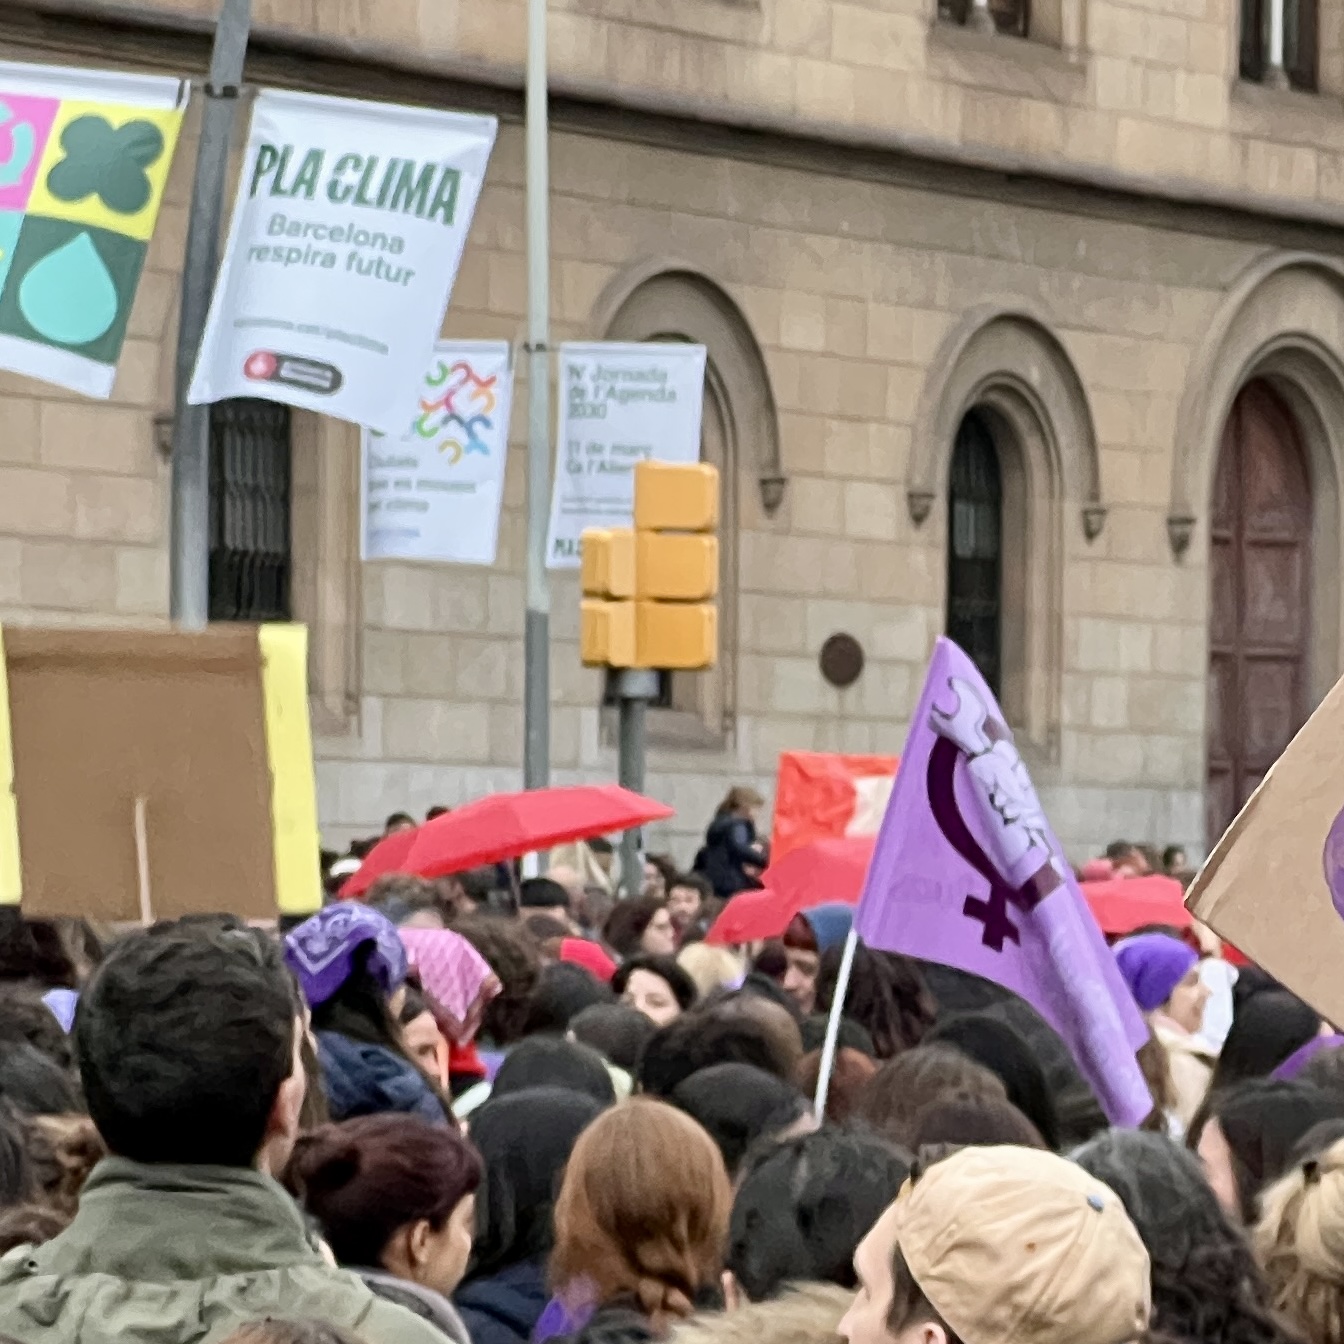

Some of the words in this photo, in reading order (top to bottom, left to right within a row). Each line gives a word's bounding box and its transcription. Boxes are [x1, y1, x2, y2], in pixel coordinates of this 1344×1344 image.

[250, 143, 327, 200] PLA
[327, 152, 461, 227] CLIMA
[267, 212, 405, 255] Barcelona
[249, 242, 336, 269] respira
[345, 251, 415, 287] futur
[590, 363, 667, 383] Jornada
